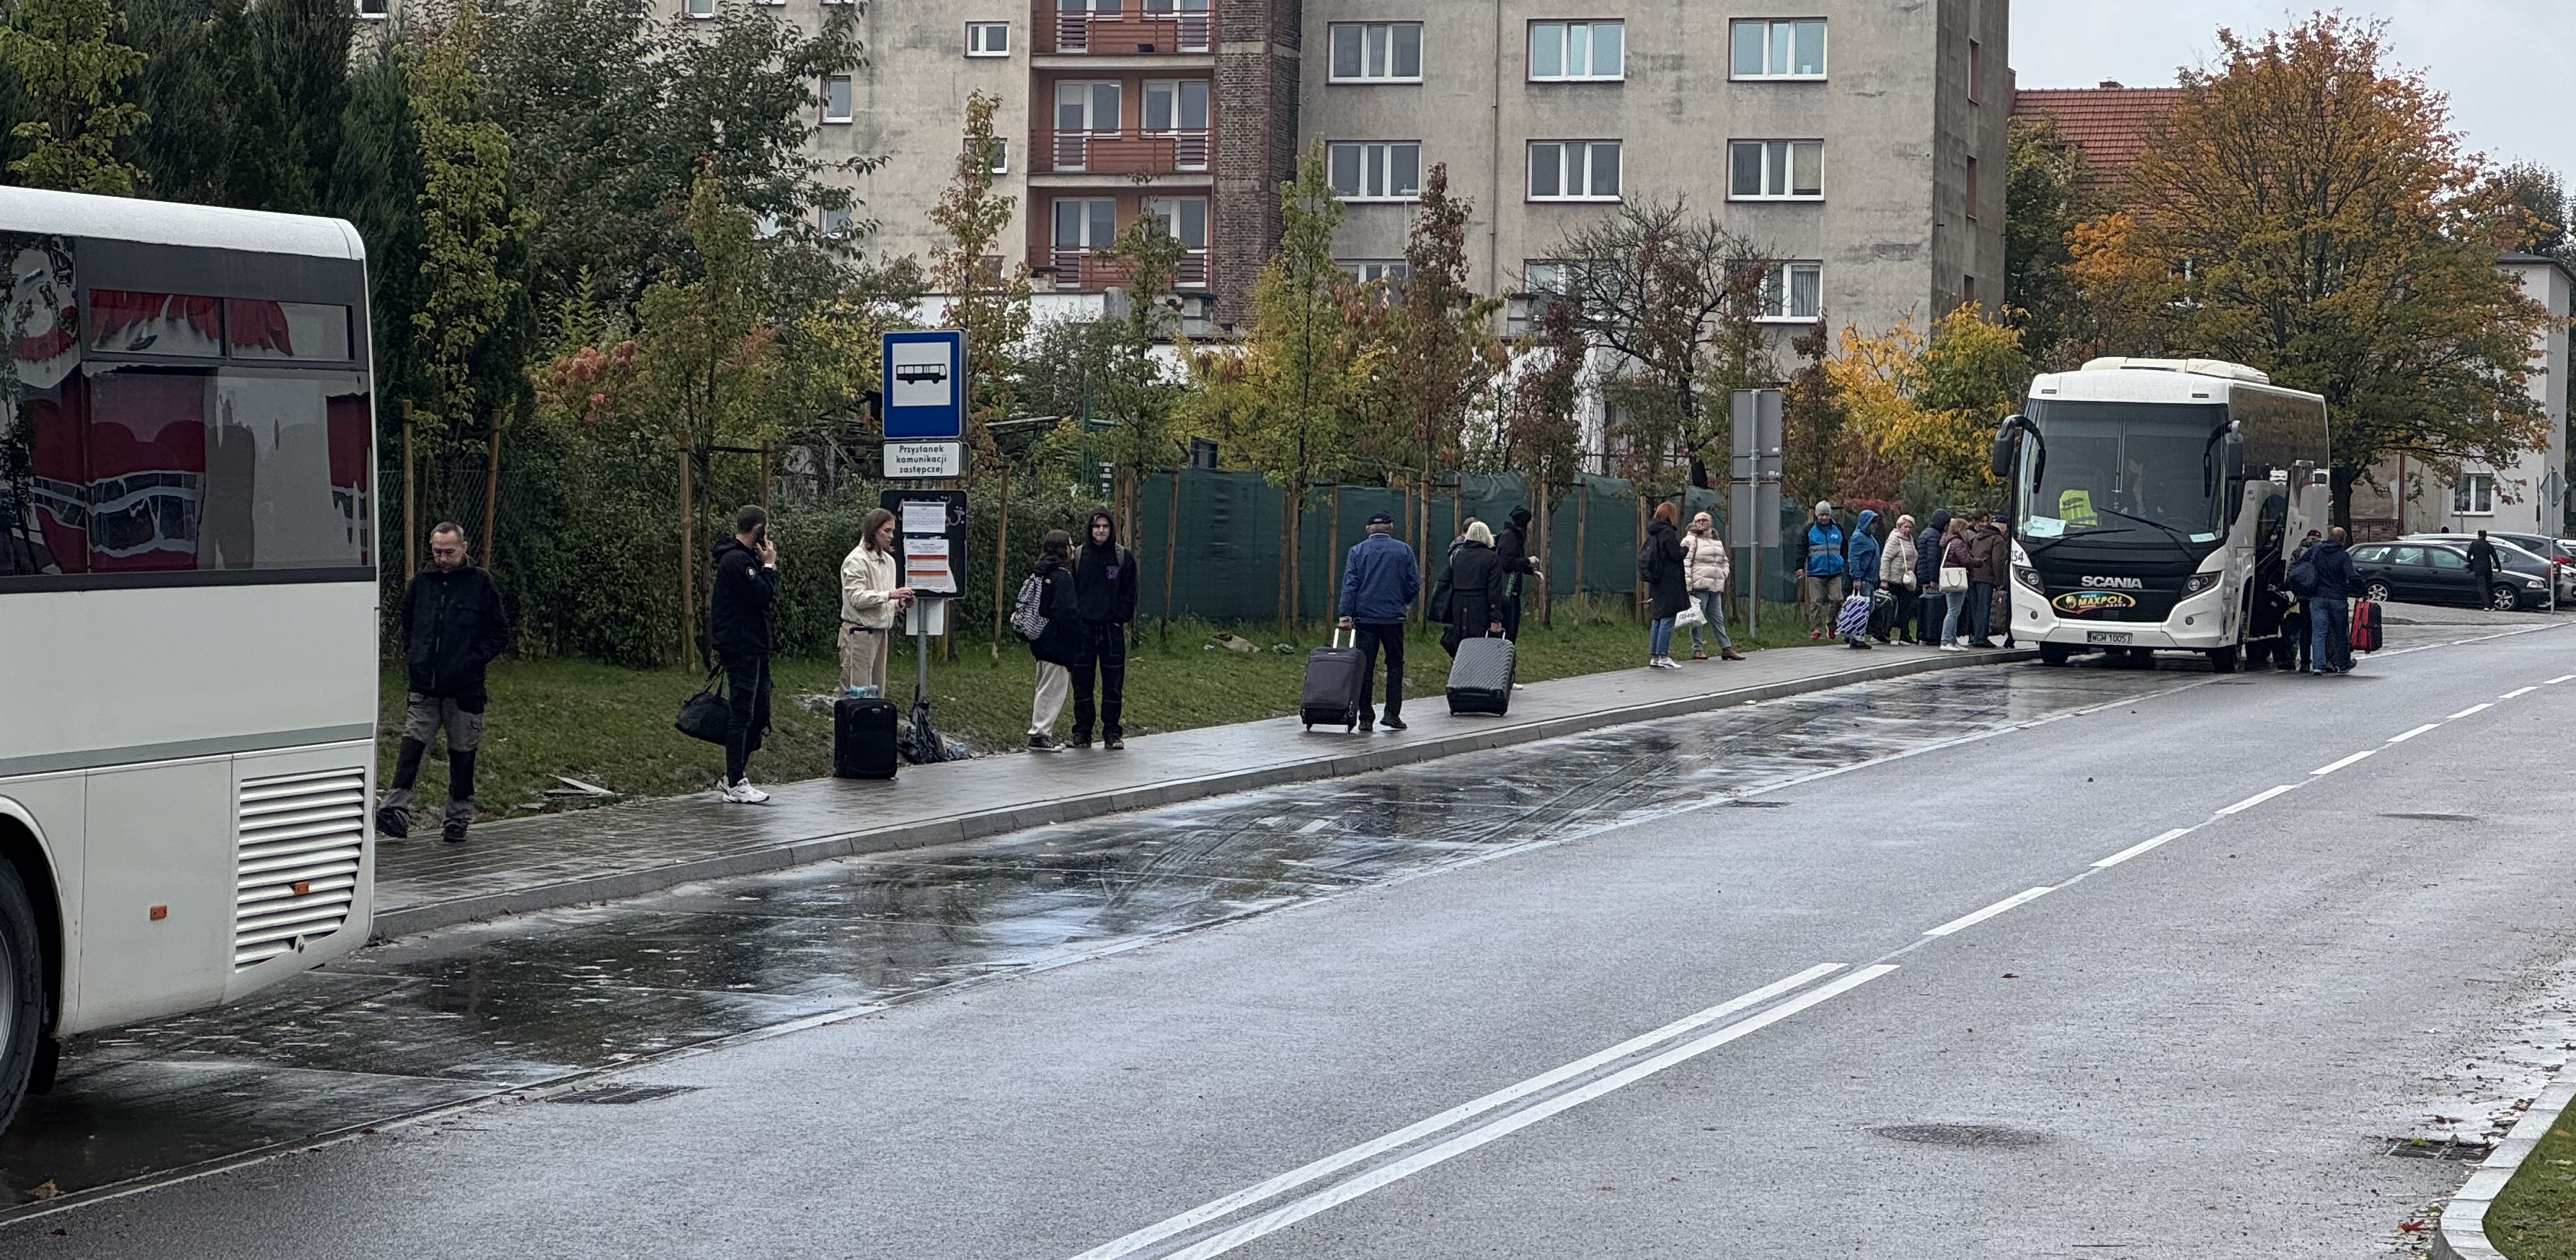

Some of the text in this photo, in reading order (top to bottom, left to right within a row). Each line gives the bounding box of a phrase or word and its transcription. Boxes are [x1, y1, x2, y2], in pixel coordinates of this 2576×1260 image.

[899, 445, 944, 454] Przystanek
[896, 454, 947, 465] komunikacji
[899, 466, 943, 475] zastępczej
[2081, 576, 2143, 589] SCANIA
[2078, 596, 2123, 606] MAXPOL
